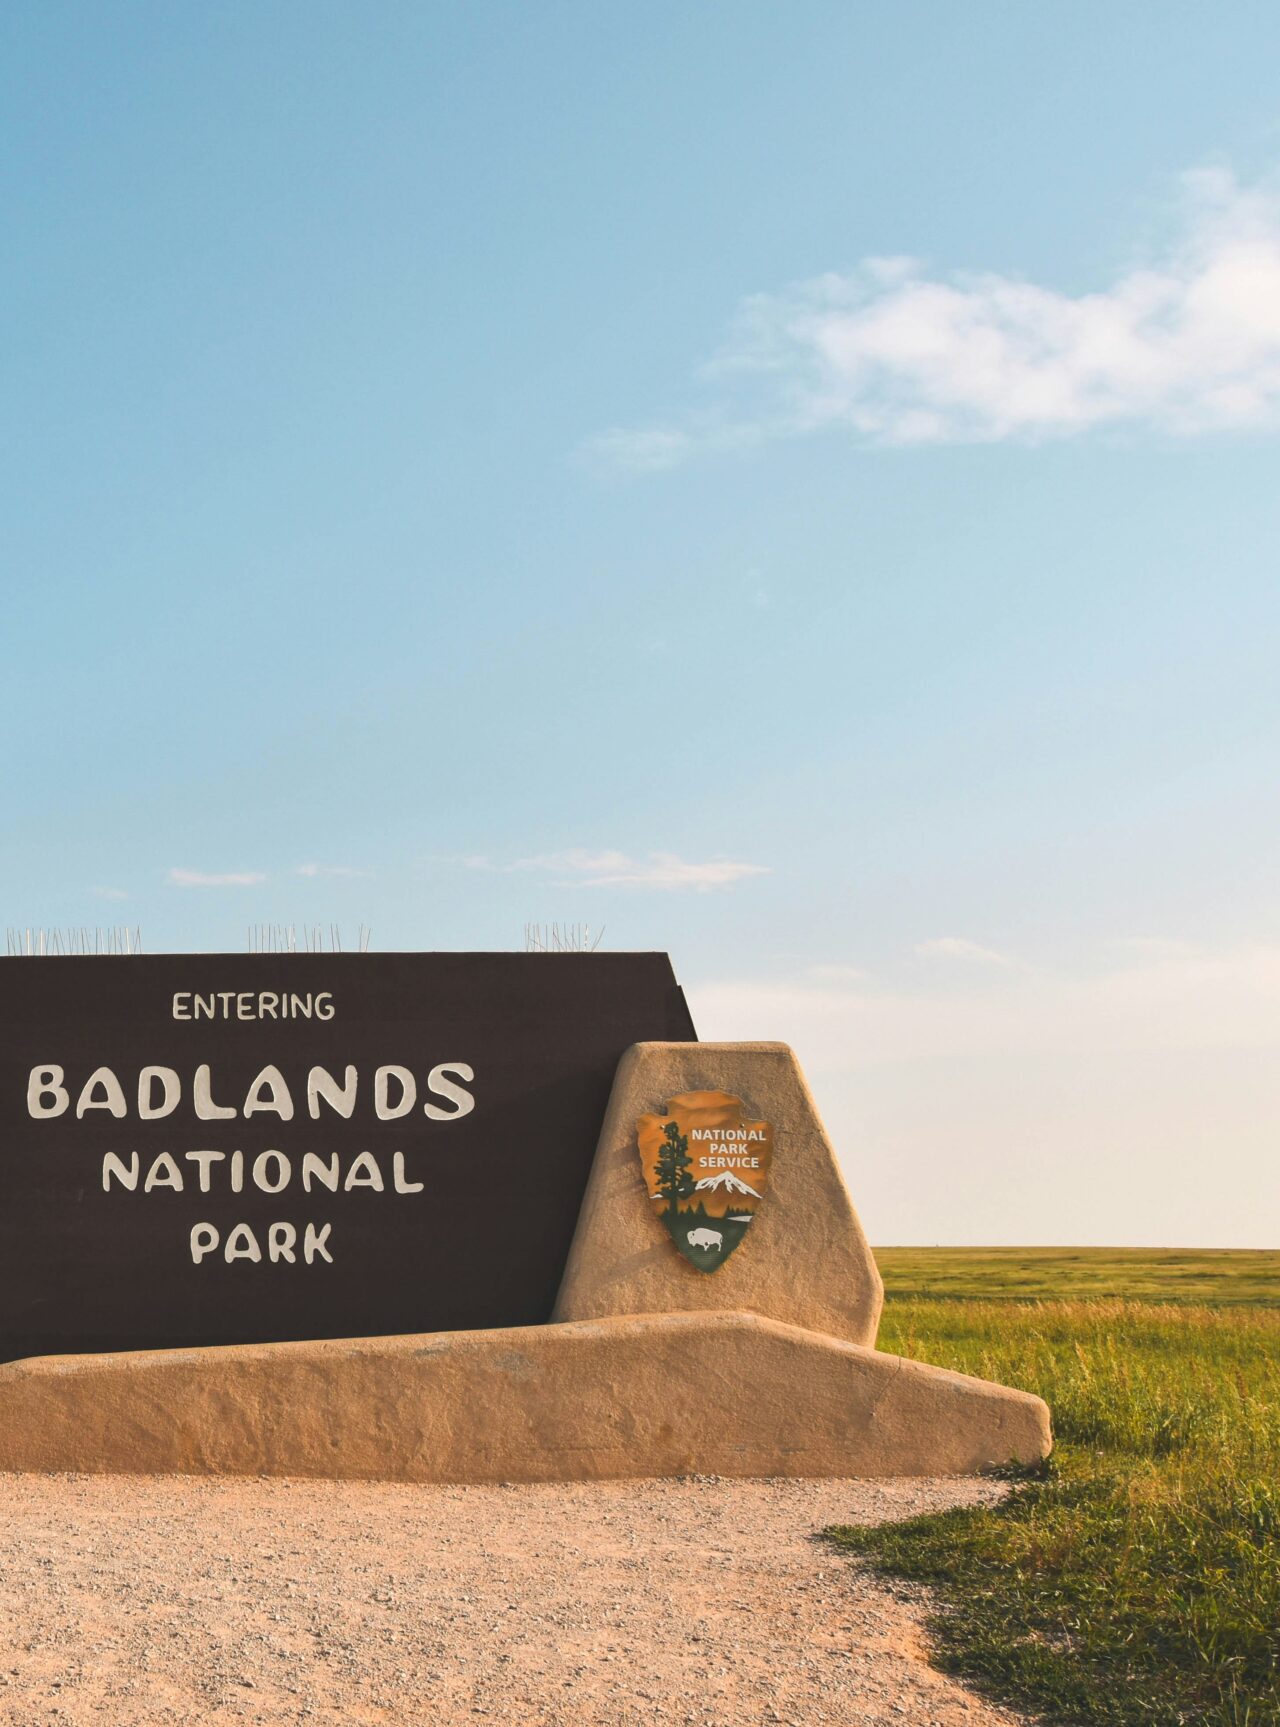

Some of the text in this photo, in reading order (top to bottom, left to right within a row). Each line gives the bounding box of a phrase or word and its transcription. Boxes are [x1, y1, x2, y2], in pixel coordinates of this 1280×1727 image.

[172, 991, 336, 1021] ENTERING
[26, 1062, 476, 1121] BADLANDS
[692, 1130, 766, 1141] NATIONAL
[710, 1144, 748, 1154] PARK
[101, 1149, 425, 1194] NATIONAL
[699, 1157, 759, 1168] SERVICE
[189, 1221, 335, 1265] PARK
